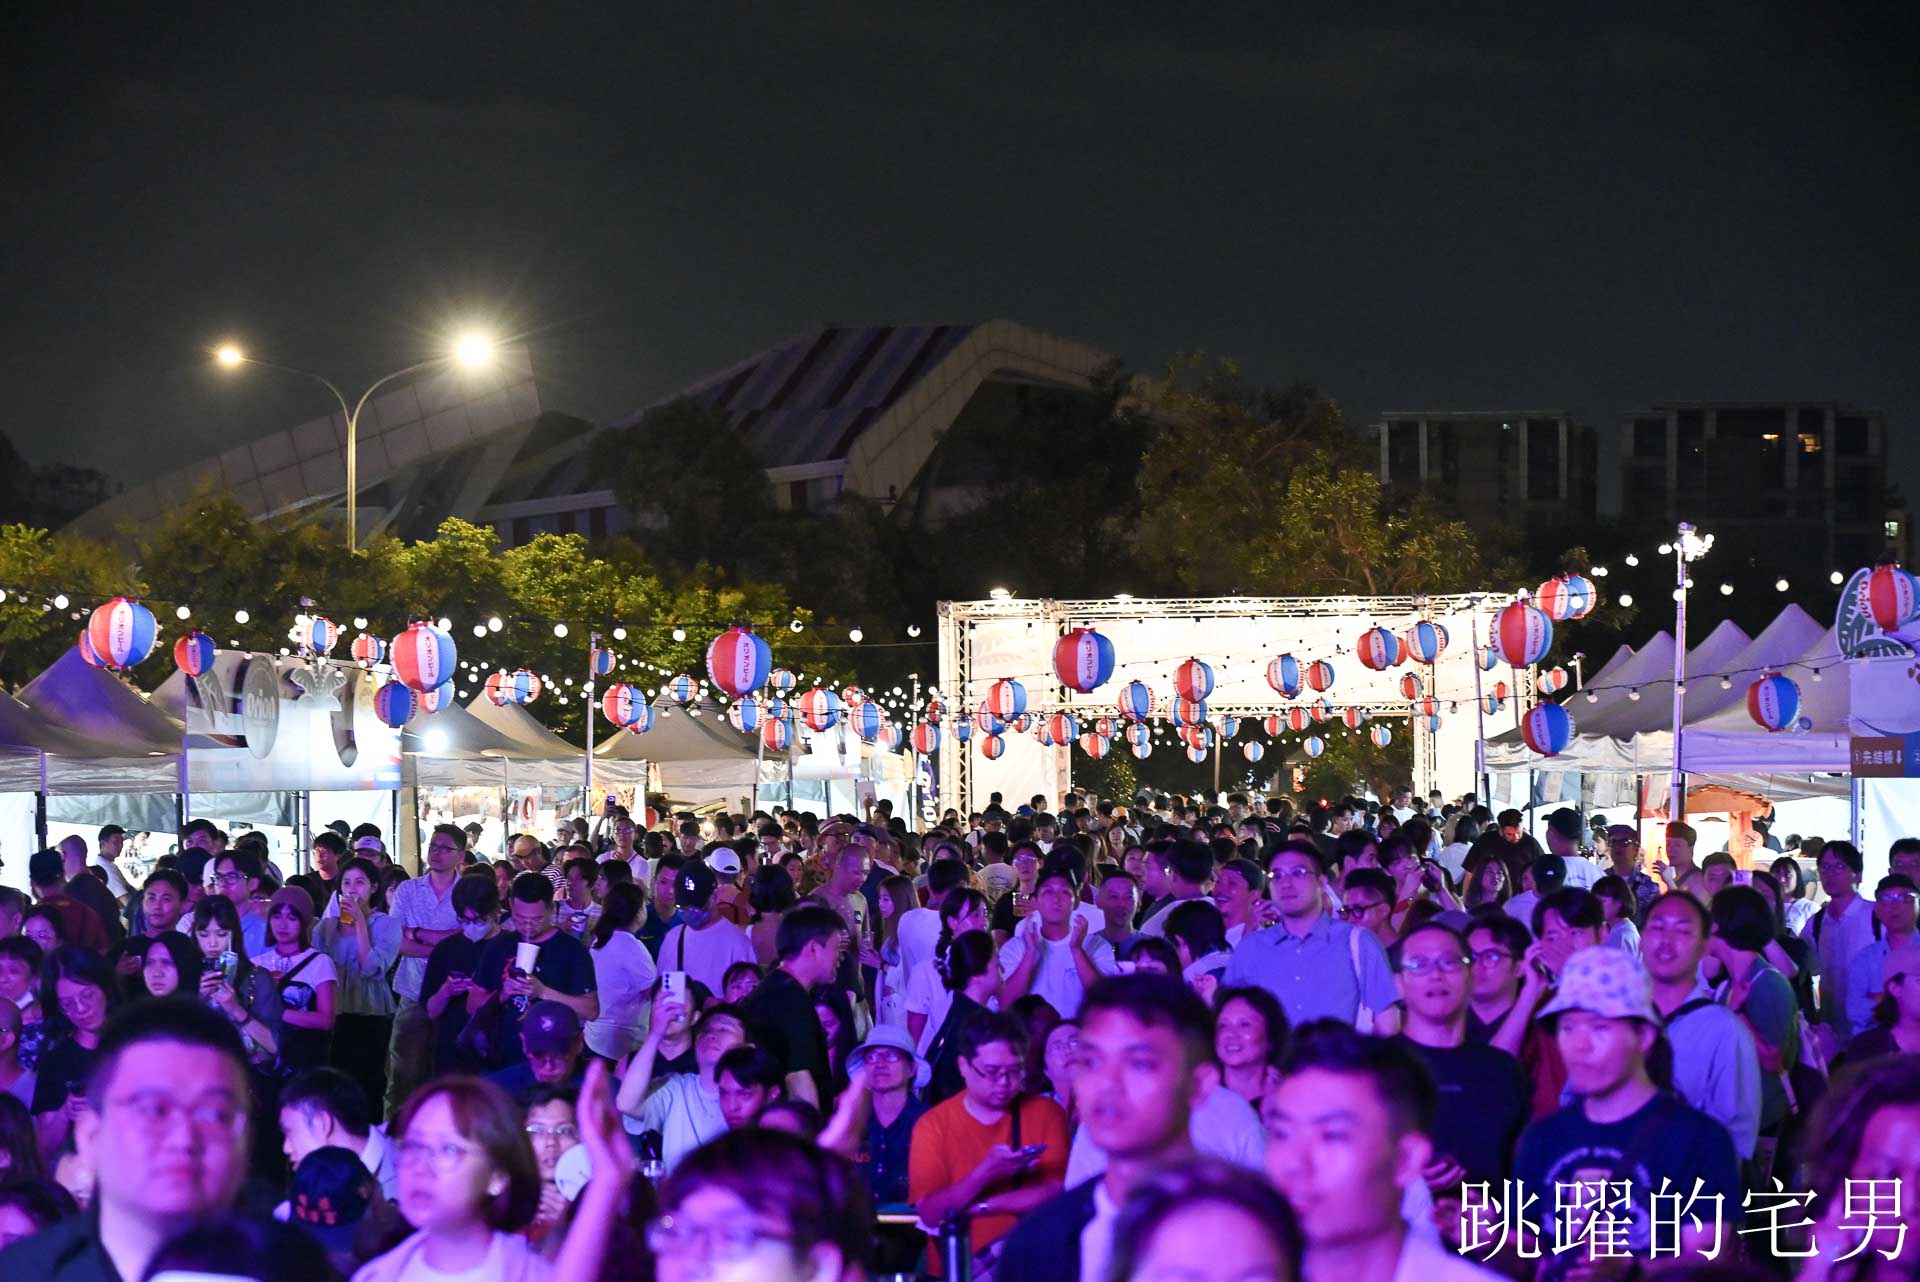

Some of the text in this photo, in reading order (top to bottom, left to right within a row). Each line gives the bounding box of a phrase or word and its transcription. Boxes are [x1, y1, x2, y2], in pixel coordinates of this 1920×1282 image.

[742, 642, 750, 684] オリオンビール
[1085, 640, 1093, 680] オリオンビール
